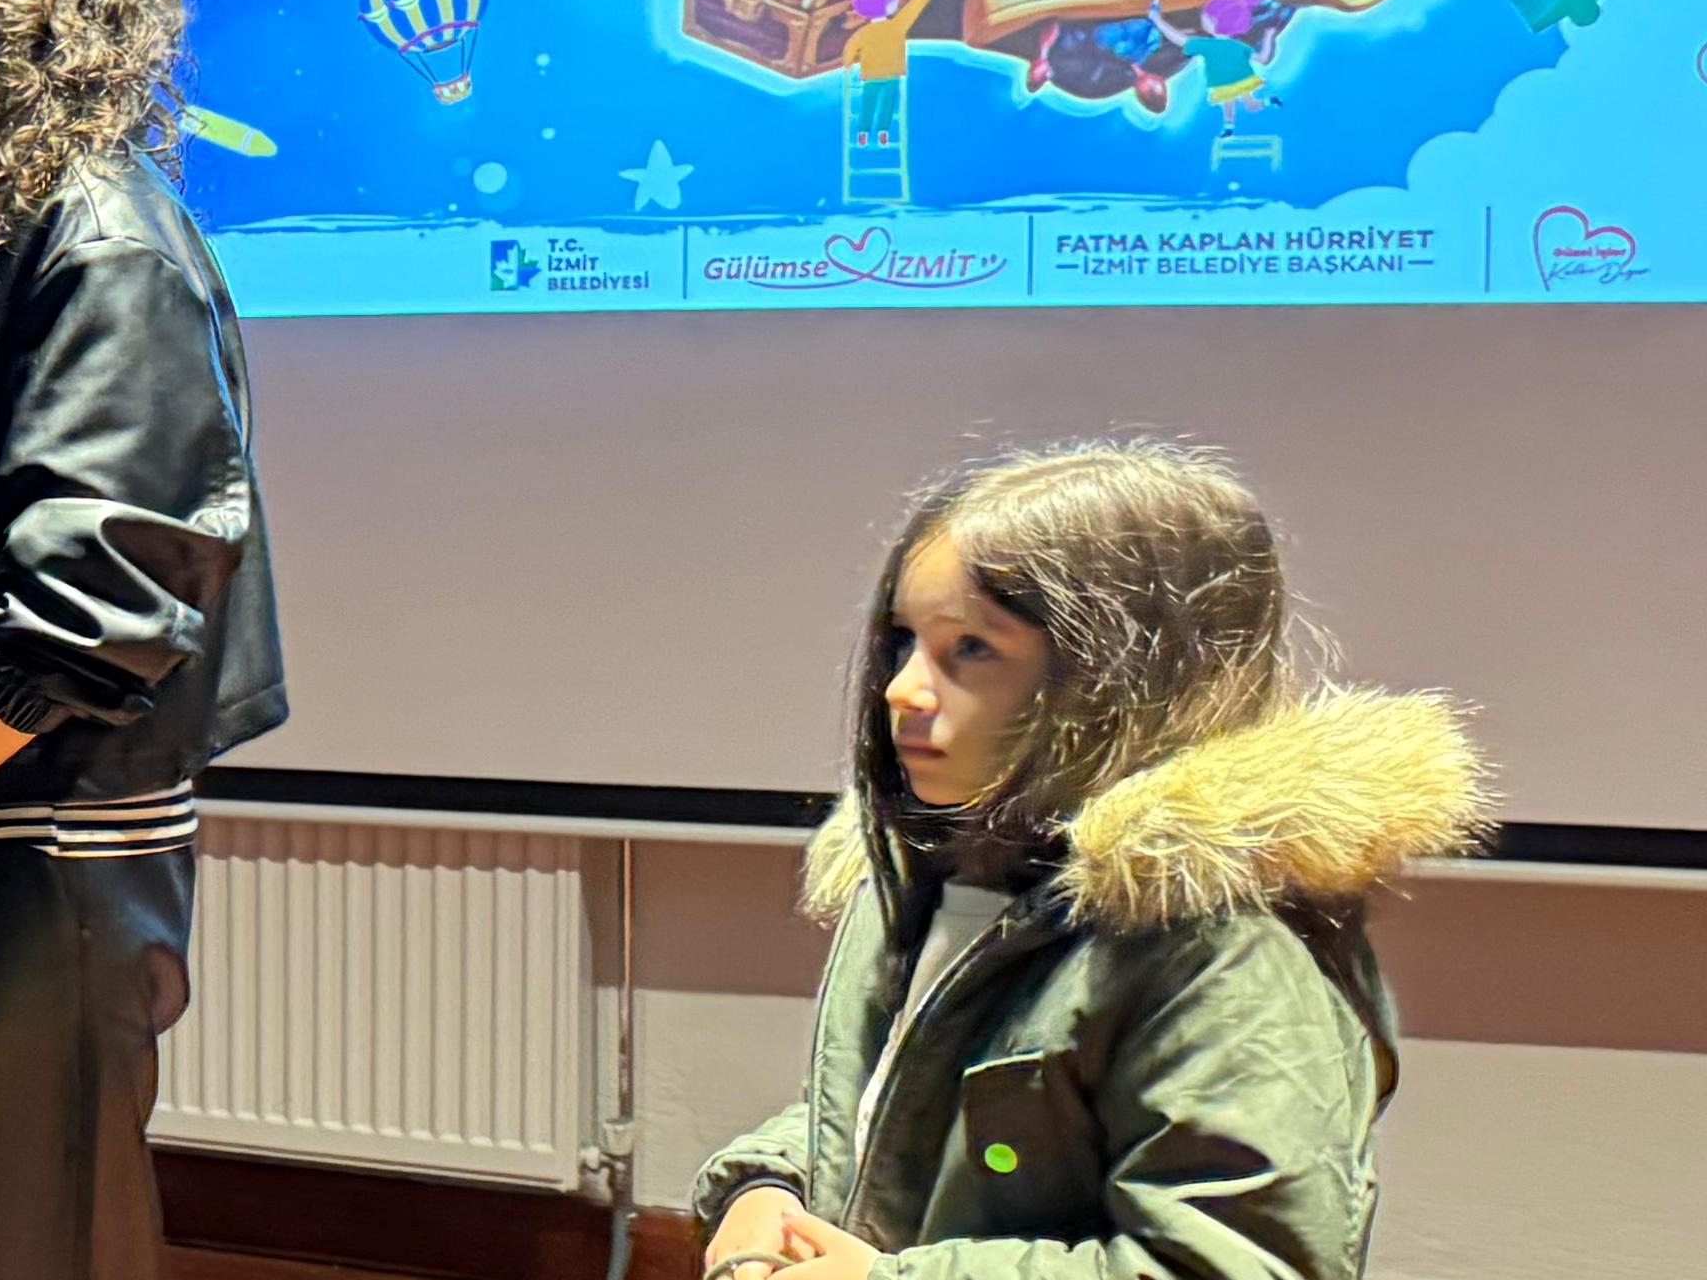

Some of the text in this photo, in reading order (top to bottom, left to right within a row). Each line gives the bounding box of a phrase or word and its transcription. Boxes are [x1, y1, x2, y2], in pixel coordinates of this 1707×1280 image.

[547, 238, 584, 252] T.C.
[1056, 226, 1435, 254] FATMA KAPLAN HÜRRİYET
[547, 254, 599, 271] İZMİT
[704, 248, 976, 280] Gülümse İZMİT
[1083, 253, 1404, 276] İZMİT BELEDİYE BAŞKANI
[547, 271, 650, 291] BELEDİYESİ
